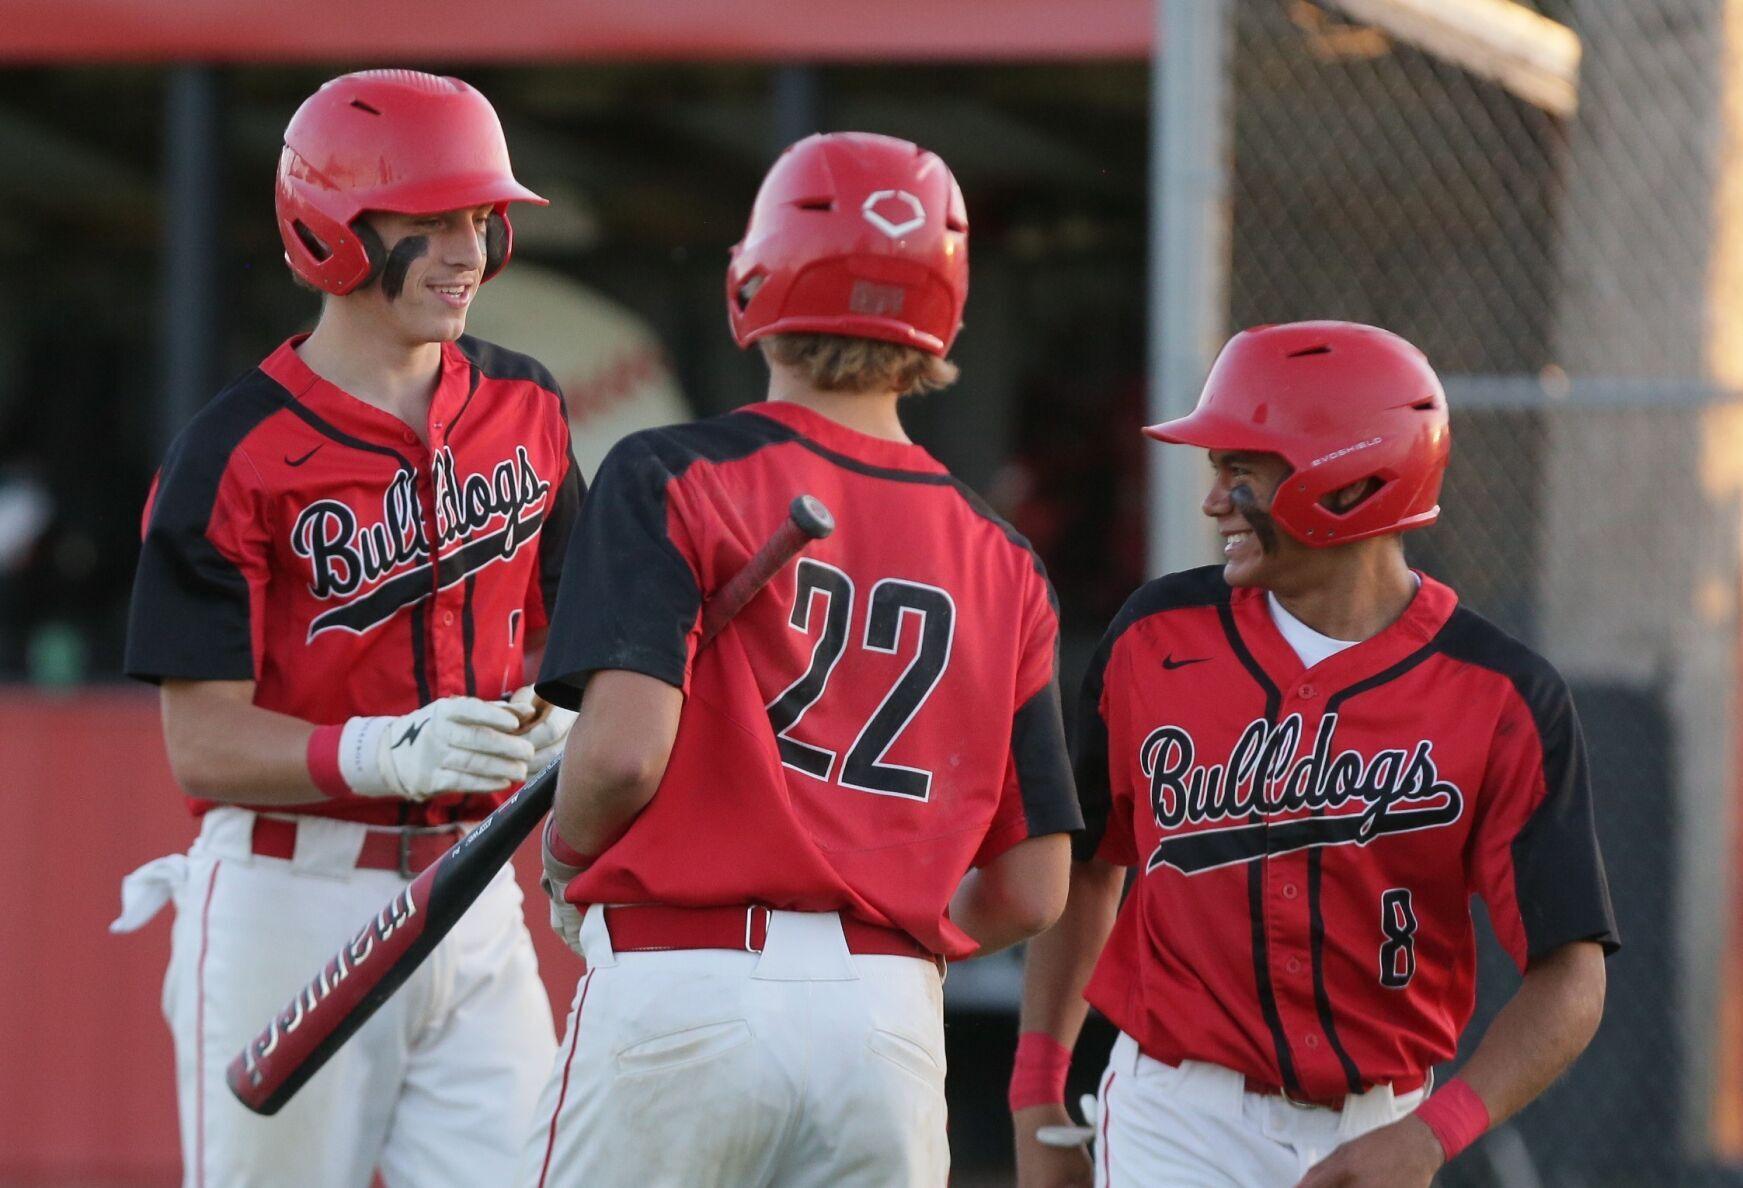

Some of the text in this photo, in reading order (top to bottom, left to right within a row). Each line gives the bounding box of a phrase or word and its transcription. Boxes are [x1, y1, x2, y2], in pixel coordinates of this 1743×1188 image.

[1311, 436, 1382, 466] EVOSHIELD
[291, 444, 552, 601] Bulldogs
[765, 557, 957, 803] 22
[1140, 712, 1462, 847] Bulldogs
[1378, 888, 1418, 990] 8
